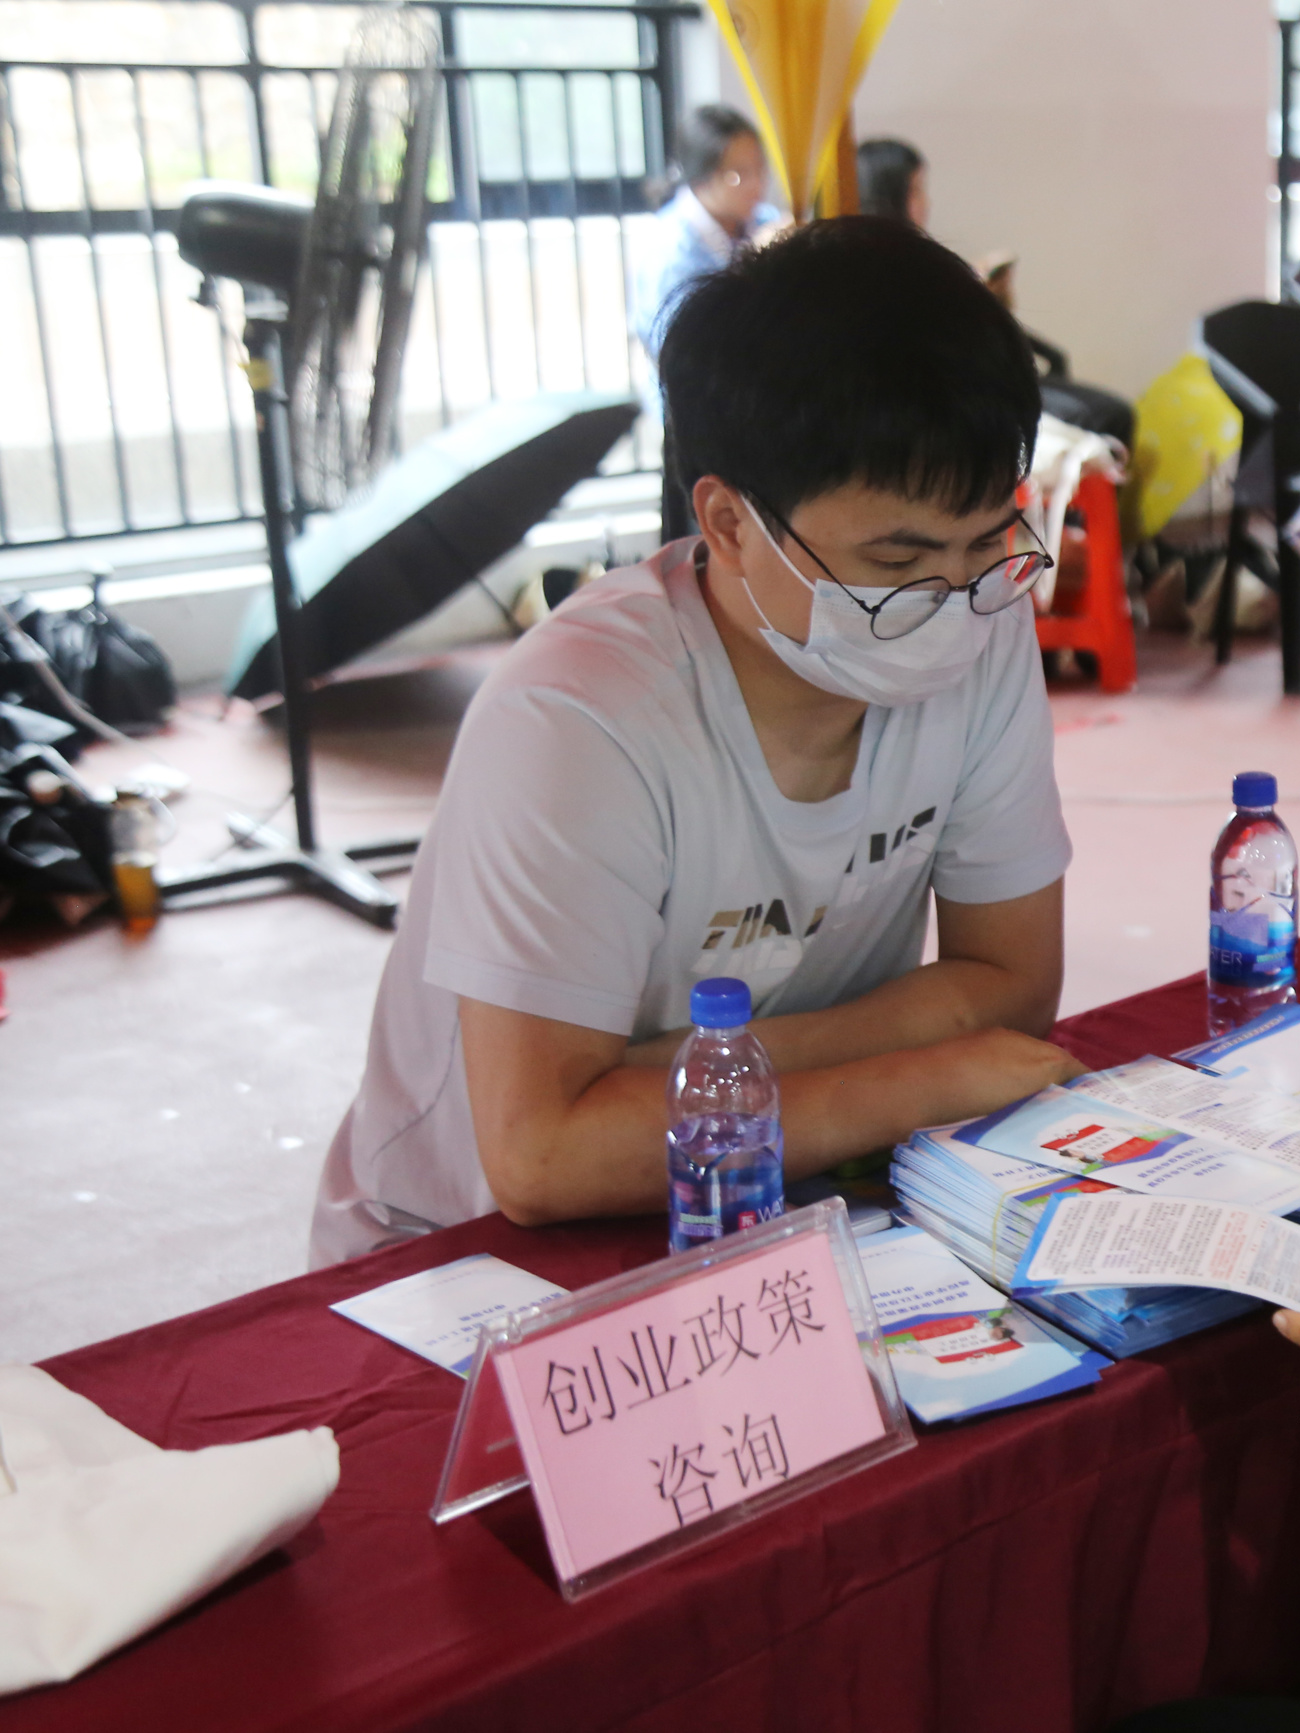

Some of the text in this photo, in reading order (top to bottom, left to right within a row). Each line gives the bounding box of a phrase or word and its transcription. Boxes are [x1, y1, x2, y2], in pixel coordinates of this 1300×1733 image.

[541, 1269, 827, 1435] 创业政策
[650, 1413, 792, 1529] 咨询
